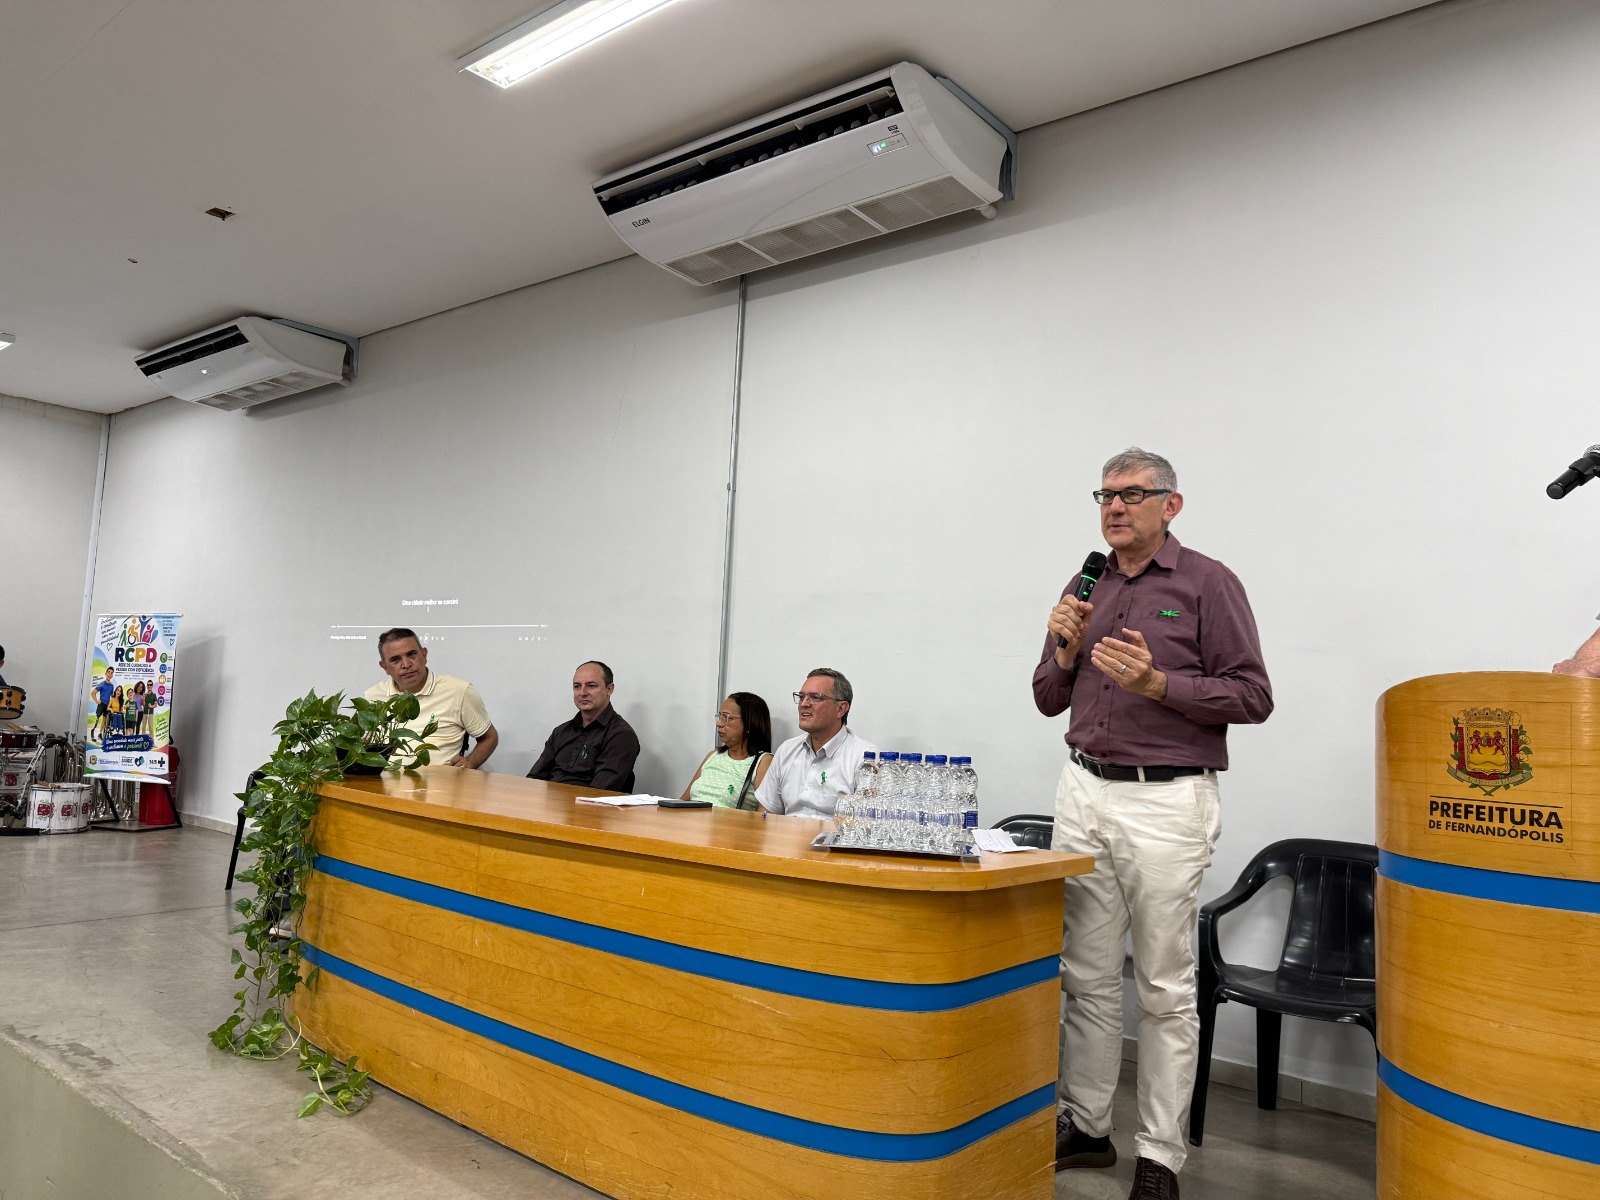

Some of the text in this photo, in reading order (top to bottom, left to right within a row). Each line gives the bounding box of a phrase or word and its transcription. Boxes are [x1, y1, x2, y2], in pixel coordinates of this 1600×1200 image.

[631, 217, 651, 228] ELGIN
[115, 647, 158, 663] RCPD
[1429, 800, 1564, 830] PREFEITURA
[1428, 819, 1564, 844] DE FERNANDÓPOLIS
